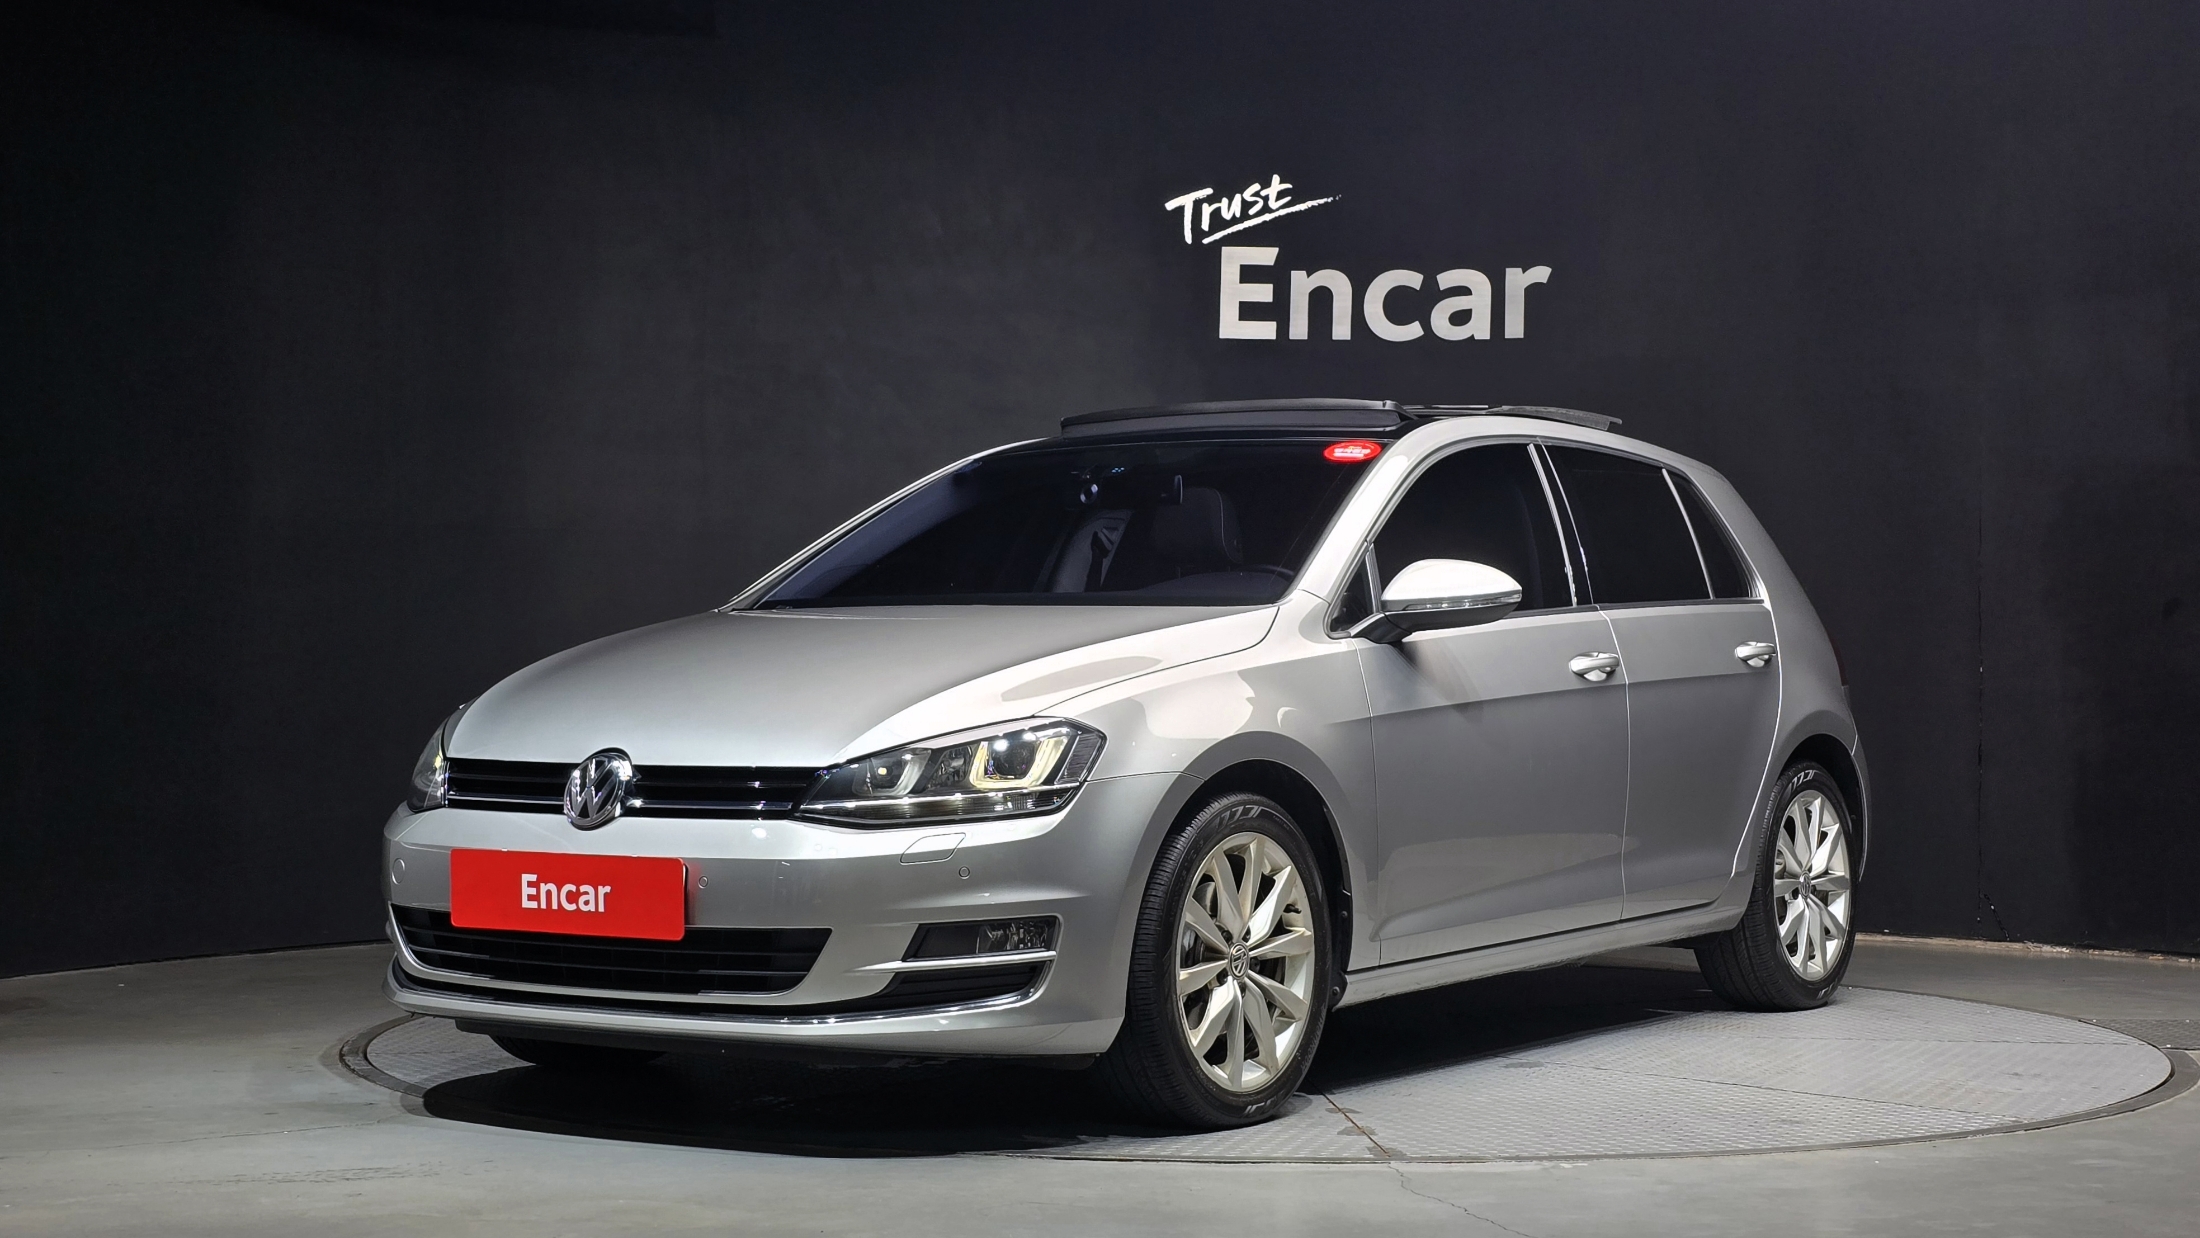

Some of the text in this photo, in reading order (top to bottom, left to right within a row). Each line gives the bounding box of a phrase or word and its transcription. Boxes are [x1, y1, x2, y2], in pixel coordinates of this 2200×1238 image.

[1165, 174, 1294, 244] Trust
[1218, 246, 1553, 342] Encar
[520, 873, 612, 913] Encar
